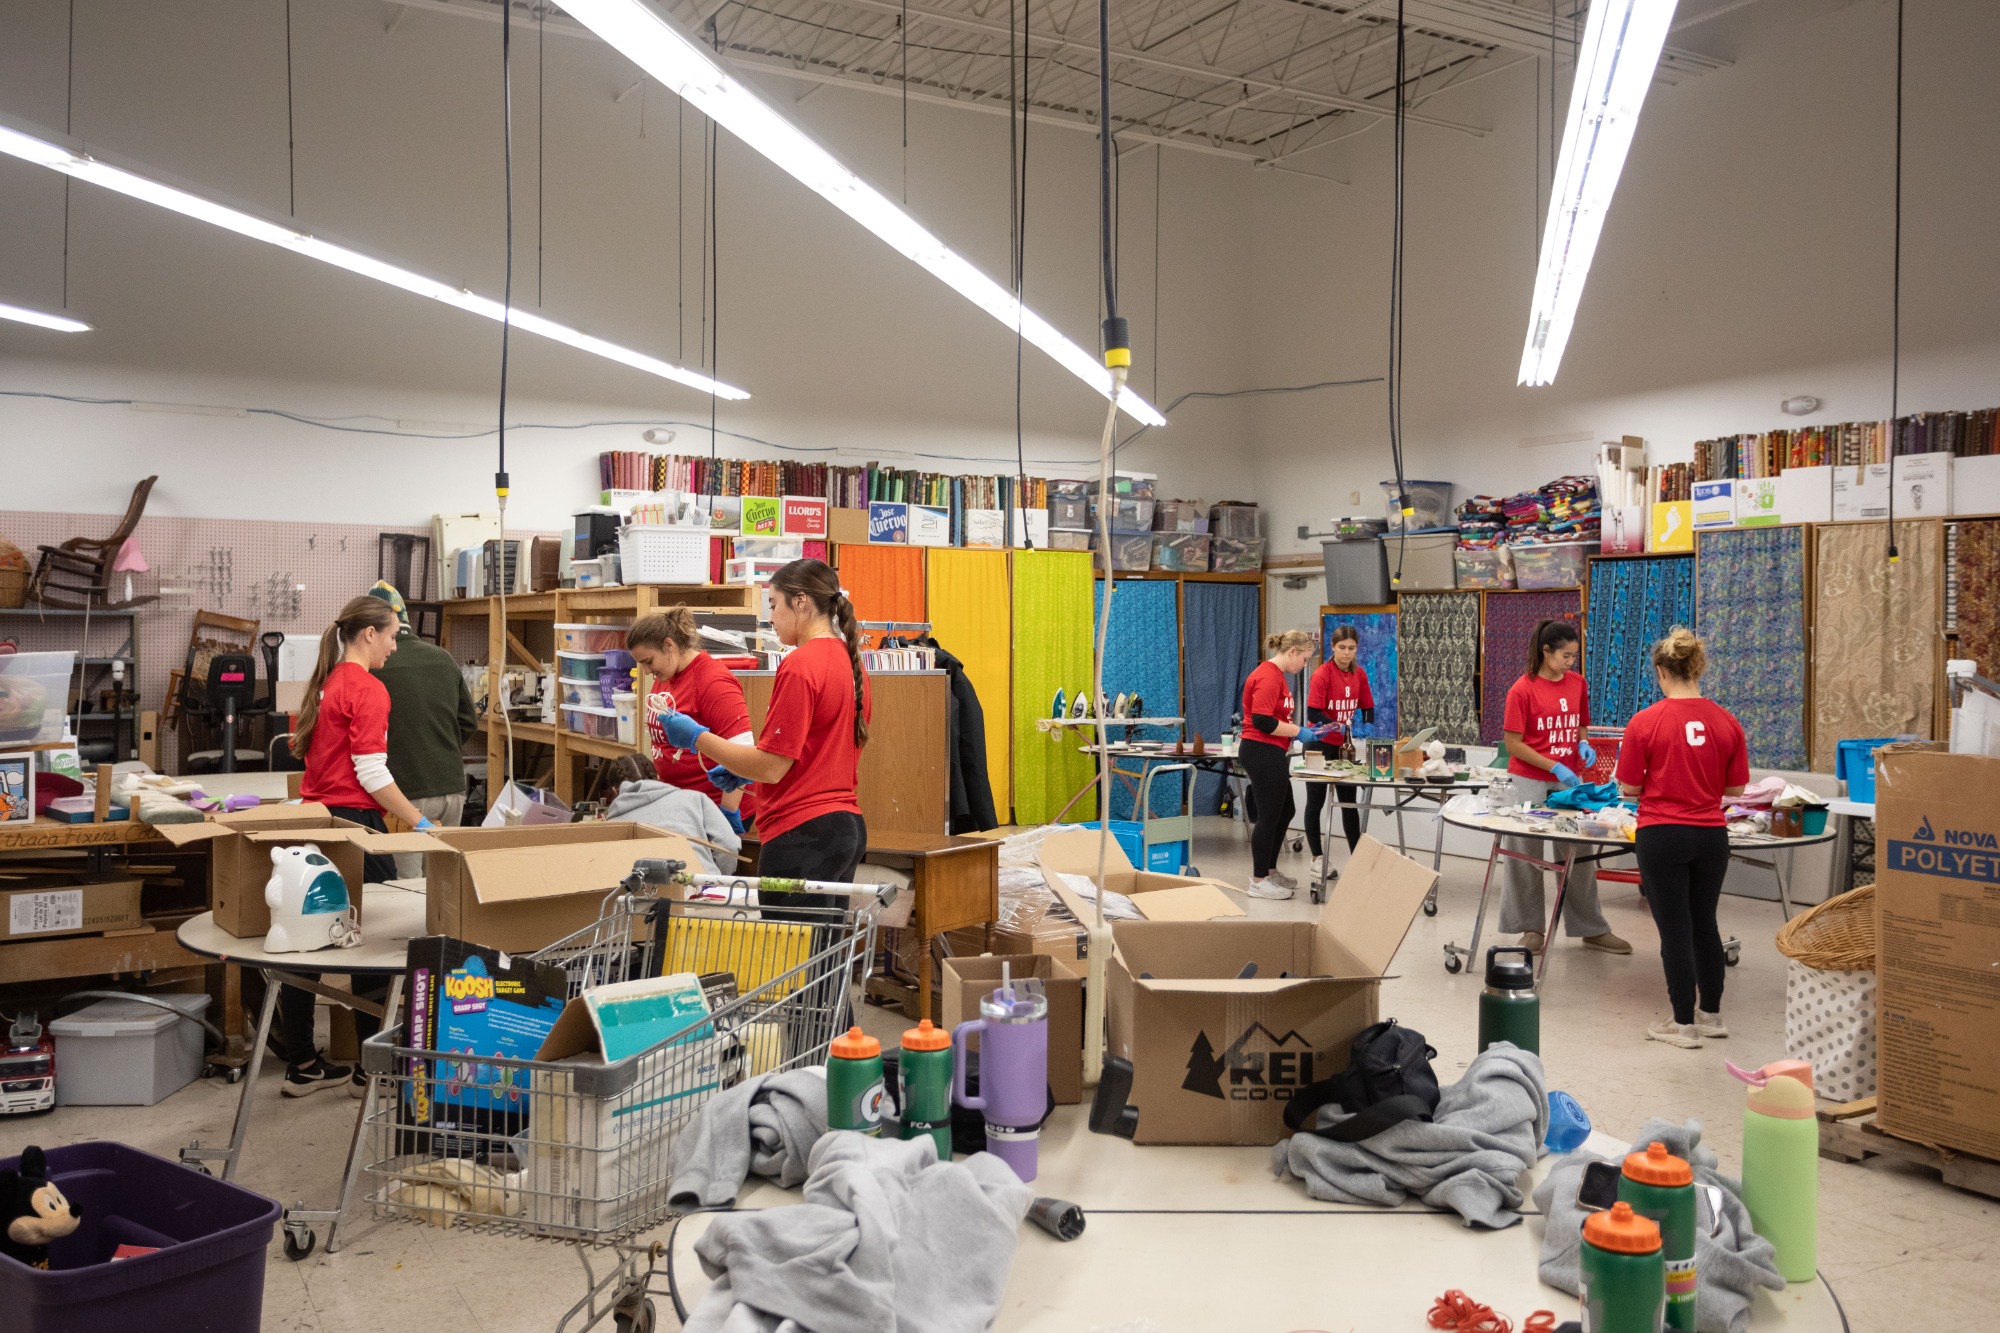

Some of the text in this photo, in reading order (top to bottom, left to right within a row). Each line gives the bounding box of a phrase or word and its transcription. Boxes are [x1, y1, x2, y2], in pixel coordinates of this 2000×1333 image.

[745, 506, 776, 523] Cuervo
[788, 506, 821, 516] LLORD'S
[878, 508, 895, 519] Jose
[757, 520, 773, 530] MIX
[870, 514, 906, 537] Cuervo
[1345, 686, 1351, 698] 8
[1328, 698, 1360, 711] AGAINS
[1559, 698, 1569, 712] 8
[1537, 713, 1580, 731] AGAINS
[1549, 728, 1577, 743] HATE
[1685, 720, 1706, 746] C
[0, 831, 58, 847] thaca
[65, 827, 120, 844] Fixers
[1944, 829, 1998, 849] NOVA
[1901, 846, 2000, 878] POLYET
[415, 974, 427, 1010] SHOT
[445, 975, 494, 1000] KOOSH
[453, 1002, 486, 1012] SHARP SHOT
[1229, 1051, 1314, 1085] REI
[910, 1121, 933, 1130] FCA
